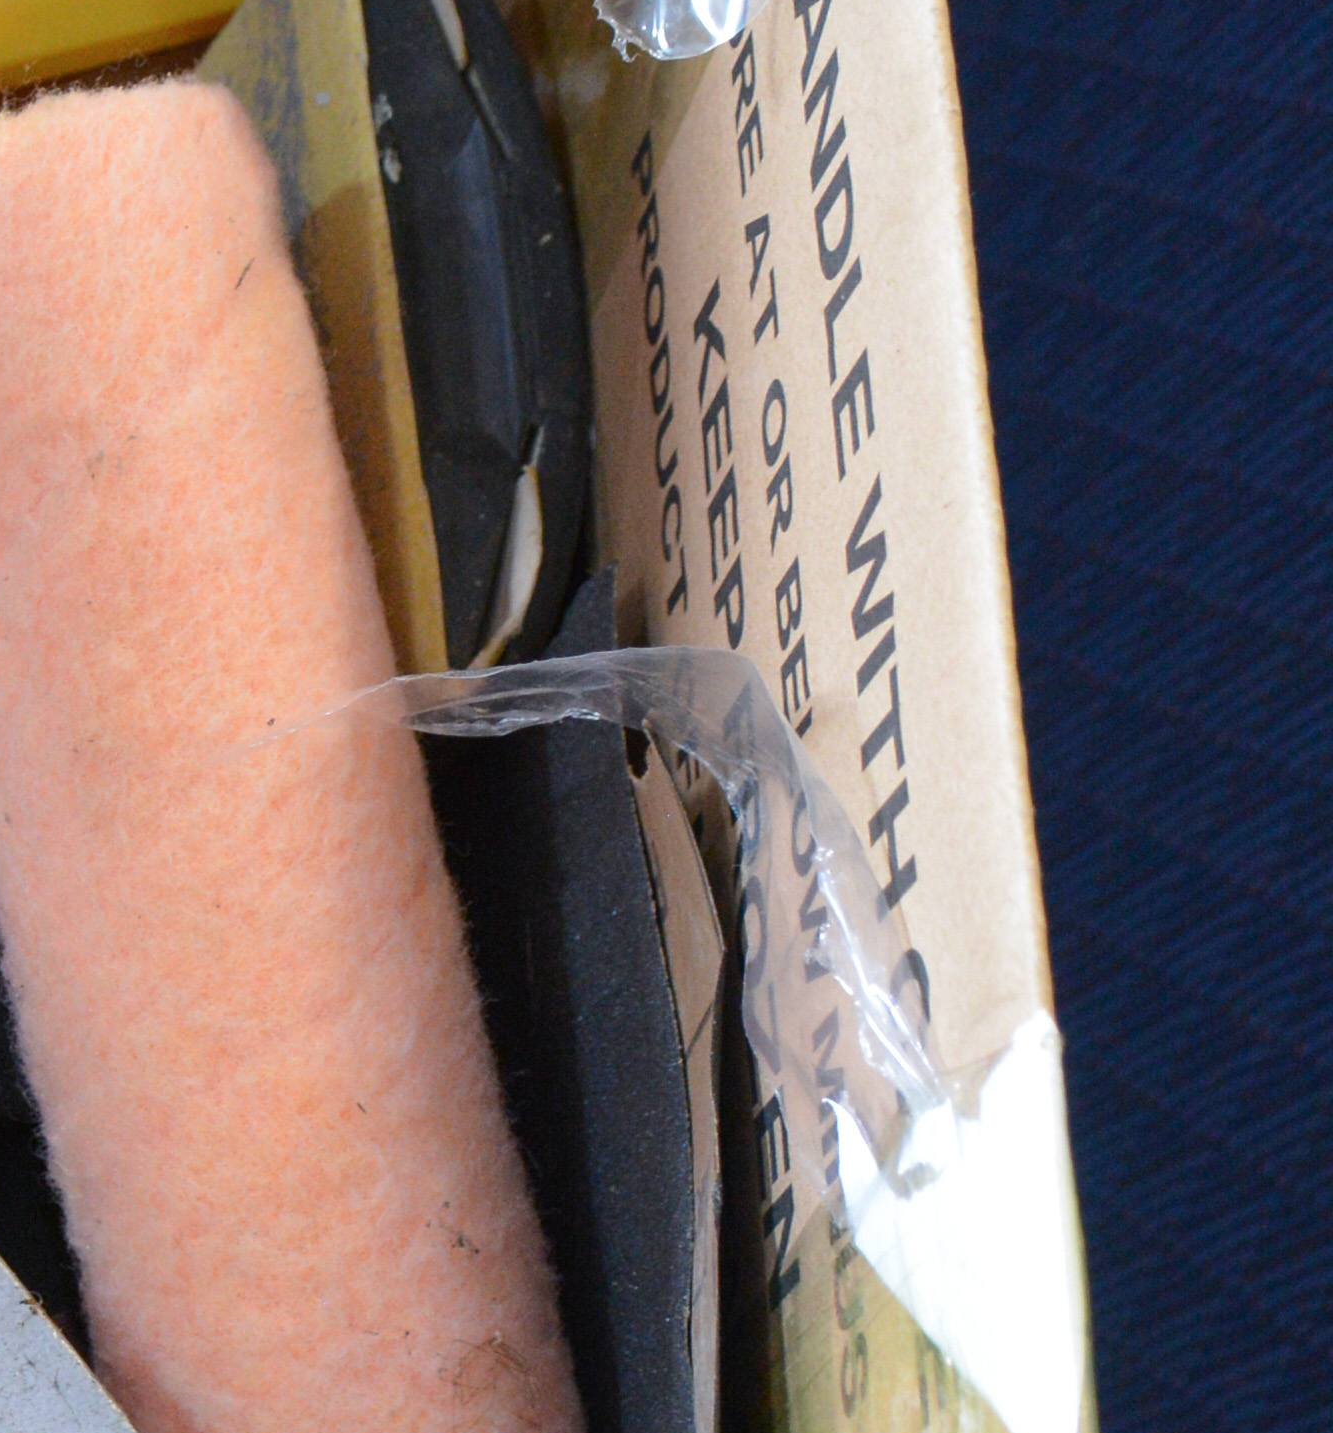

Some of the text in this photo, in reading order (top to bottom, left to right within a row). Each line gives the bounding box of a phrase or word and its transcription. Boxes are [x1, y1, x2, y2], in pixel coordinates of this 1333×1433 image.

[634, 130, 688, 615] PRODUCT
[693, 275, 745, 650] KEEP
[744, 211, 780, 346] AT
[761, 375, 794, 555] OR
[845, 471, 918, 922] WITH
